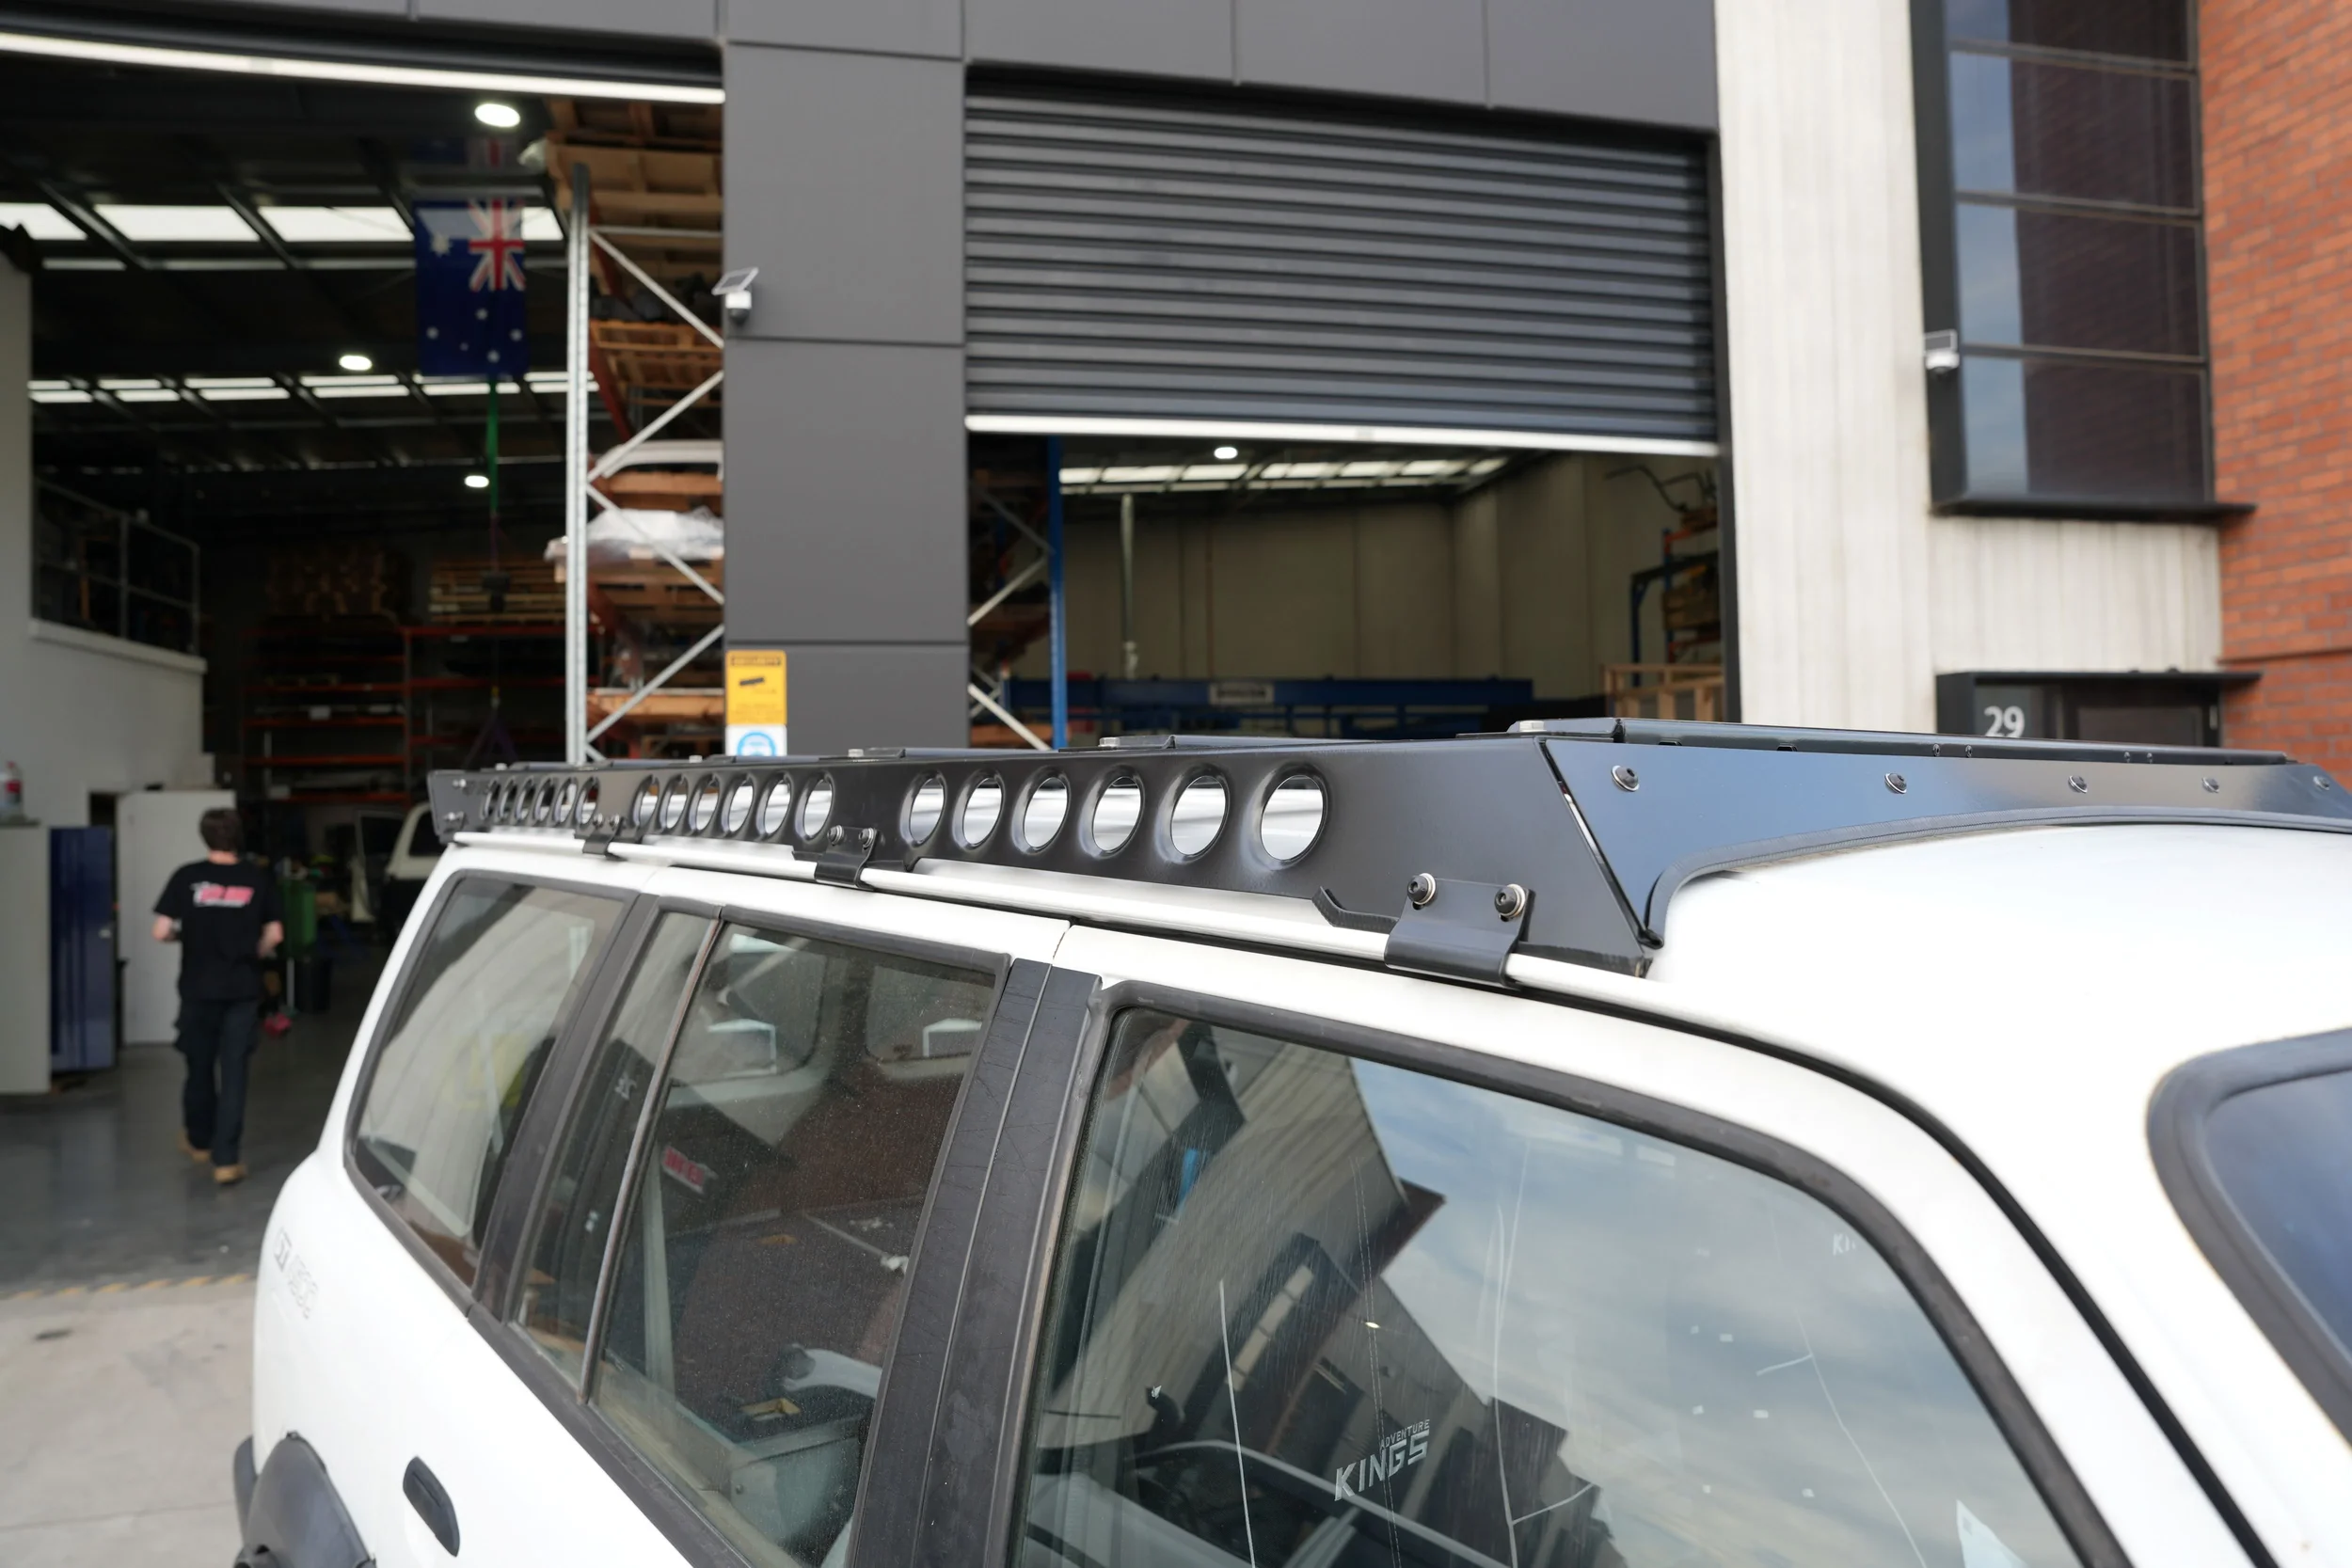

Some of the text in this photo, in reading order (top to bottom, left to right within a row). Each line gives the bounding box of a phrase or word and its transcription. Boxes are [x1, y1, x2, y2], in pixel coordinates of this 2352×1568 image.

[1983, 705, 2025, 737] 29
[1380, 1418, 1430, 1450] ADVENTURE
[1334, 1429, 1430, 1502] KINGS
